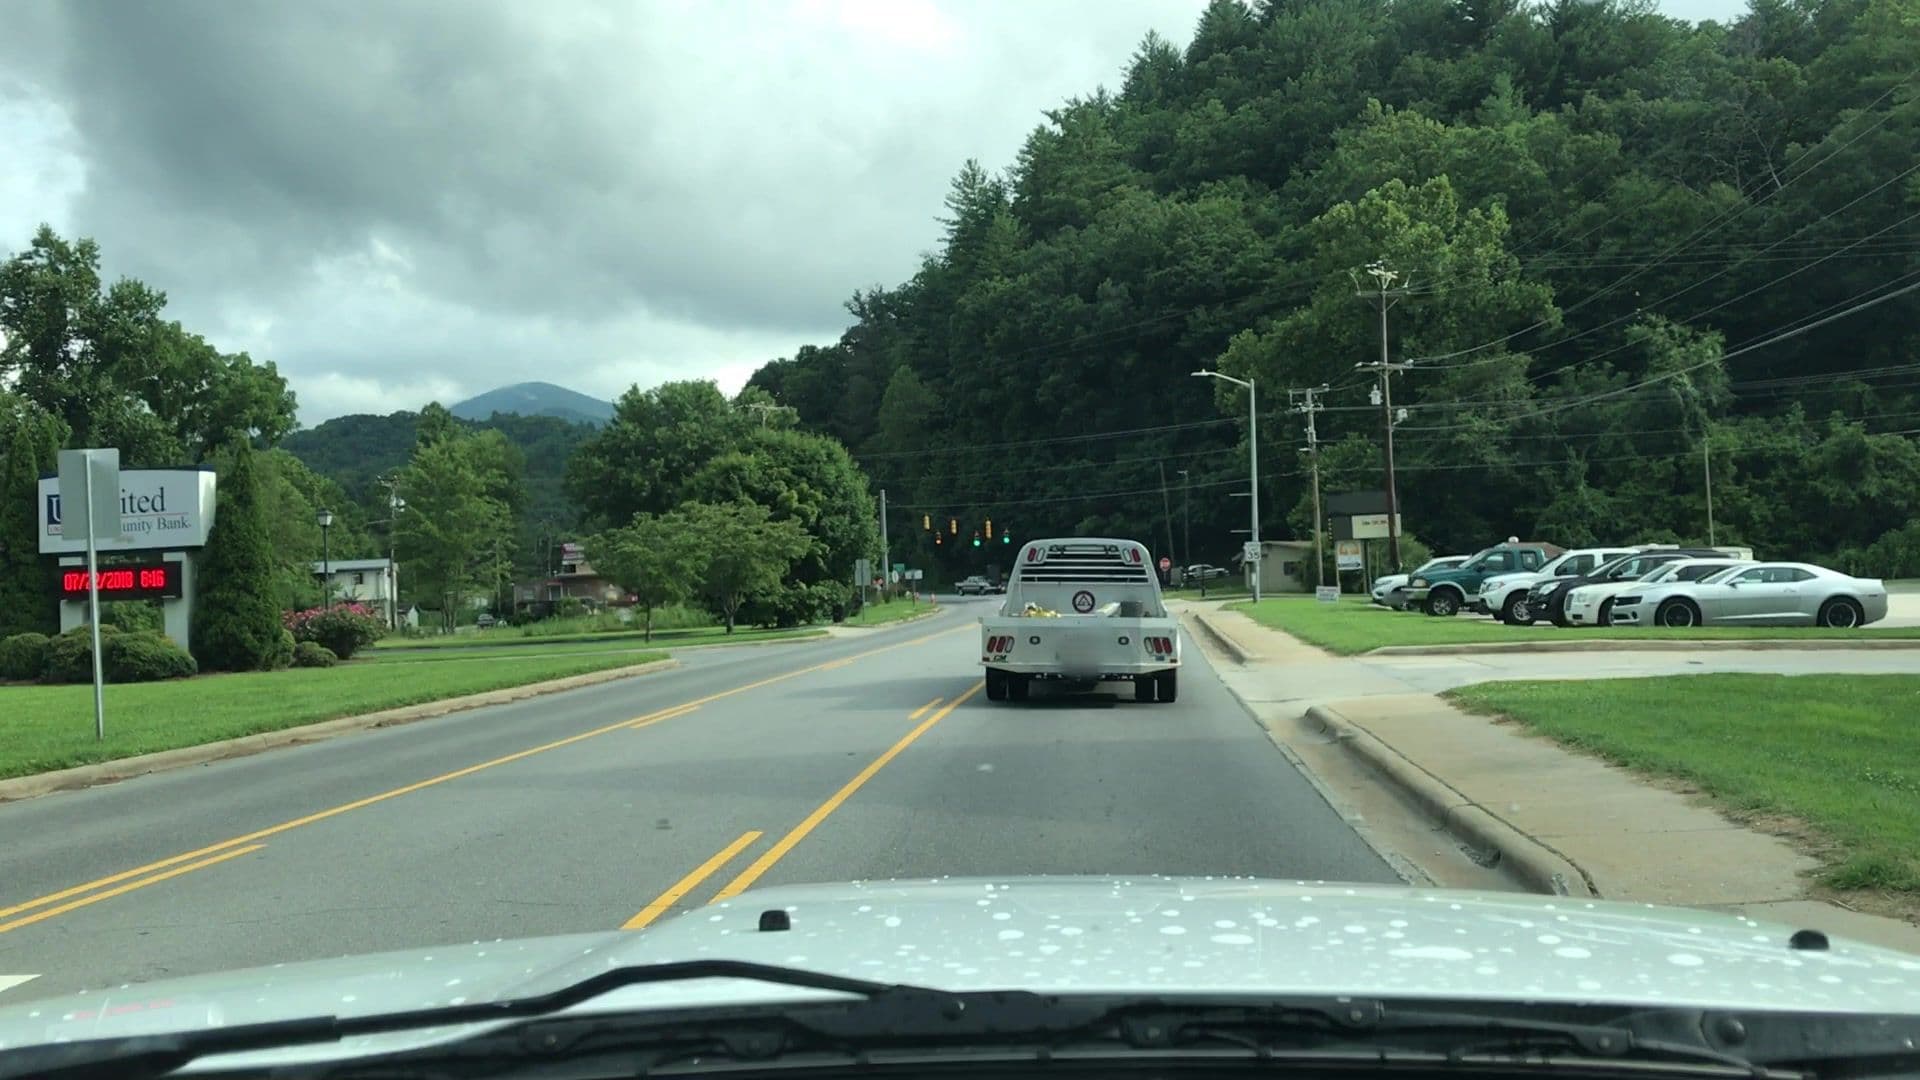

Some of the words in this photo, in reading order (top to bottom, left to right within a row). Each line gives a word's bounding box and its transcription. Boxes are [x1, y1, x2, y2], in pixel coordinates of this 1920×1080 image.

[121, 487, 166, 514] ited
[122, 519, 153, 534] unity
[1247, 551, 1260, 559] 35
[141, 570, 164, 588] 6:16
